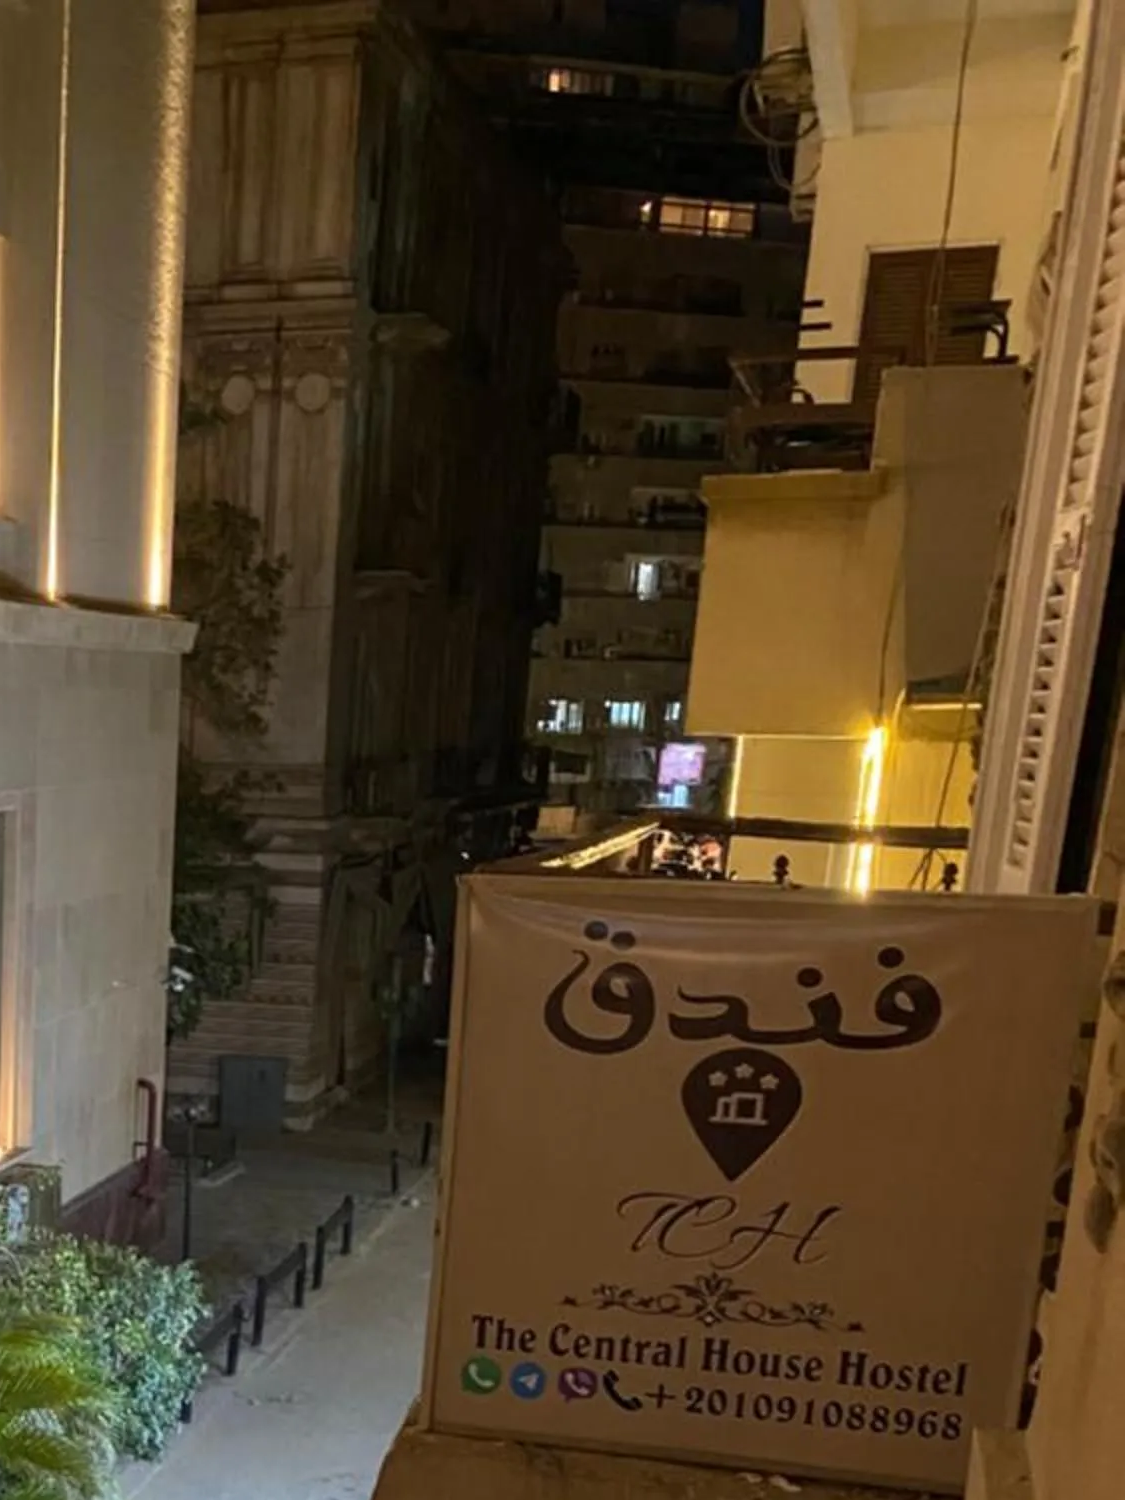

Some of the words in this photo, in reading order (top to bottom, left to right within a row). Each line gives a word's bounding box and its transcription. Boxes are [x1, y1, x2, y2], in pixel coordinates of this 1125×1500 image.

[544, 921, 942, 1054] فندق
[616, 1191, 840, 1269] TCH
[472, 1314, 537, 1353] The
[548, 1323, 687, 1369] Central
[701, 1337, 824, 1382] House
[837, 1350, 968, 1396] Hostel
